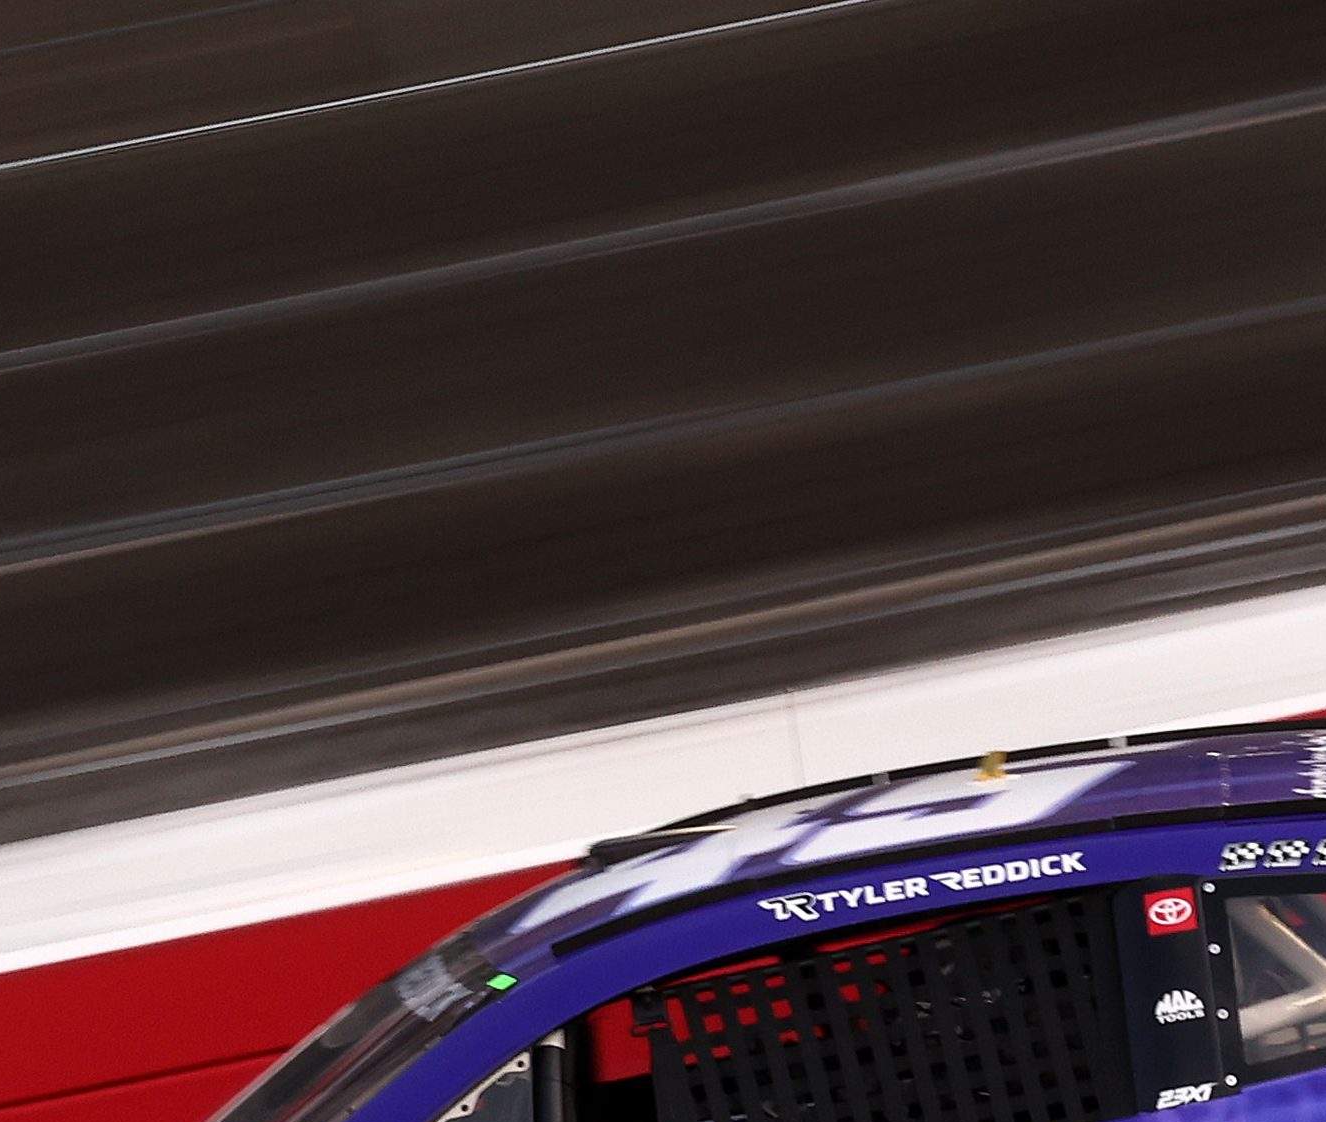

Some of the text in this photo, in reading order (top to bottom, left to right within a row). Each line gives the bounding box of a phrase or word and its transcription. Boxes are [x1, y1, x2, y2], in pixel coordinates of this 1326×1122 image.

[815, 877, 930, 912] TYLER
[929, 851, 1088, 891] REDDICK
[1154, 989, 1205, 1016] MAC
[1155, 1008, 1206, 1025] TOOLS
